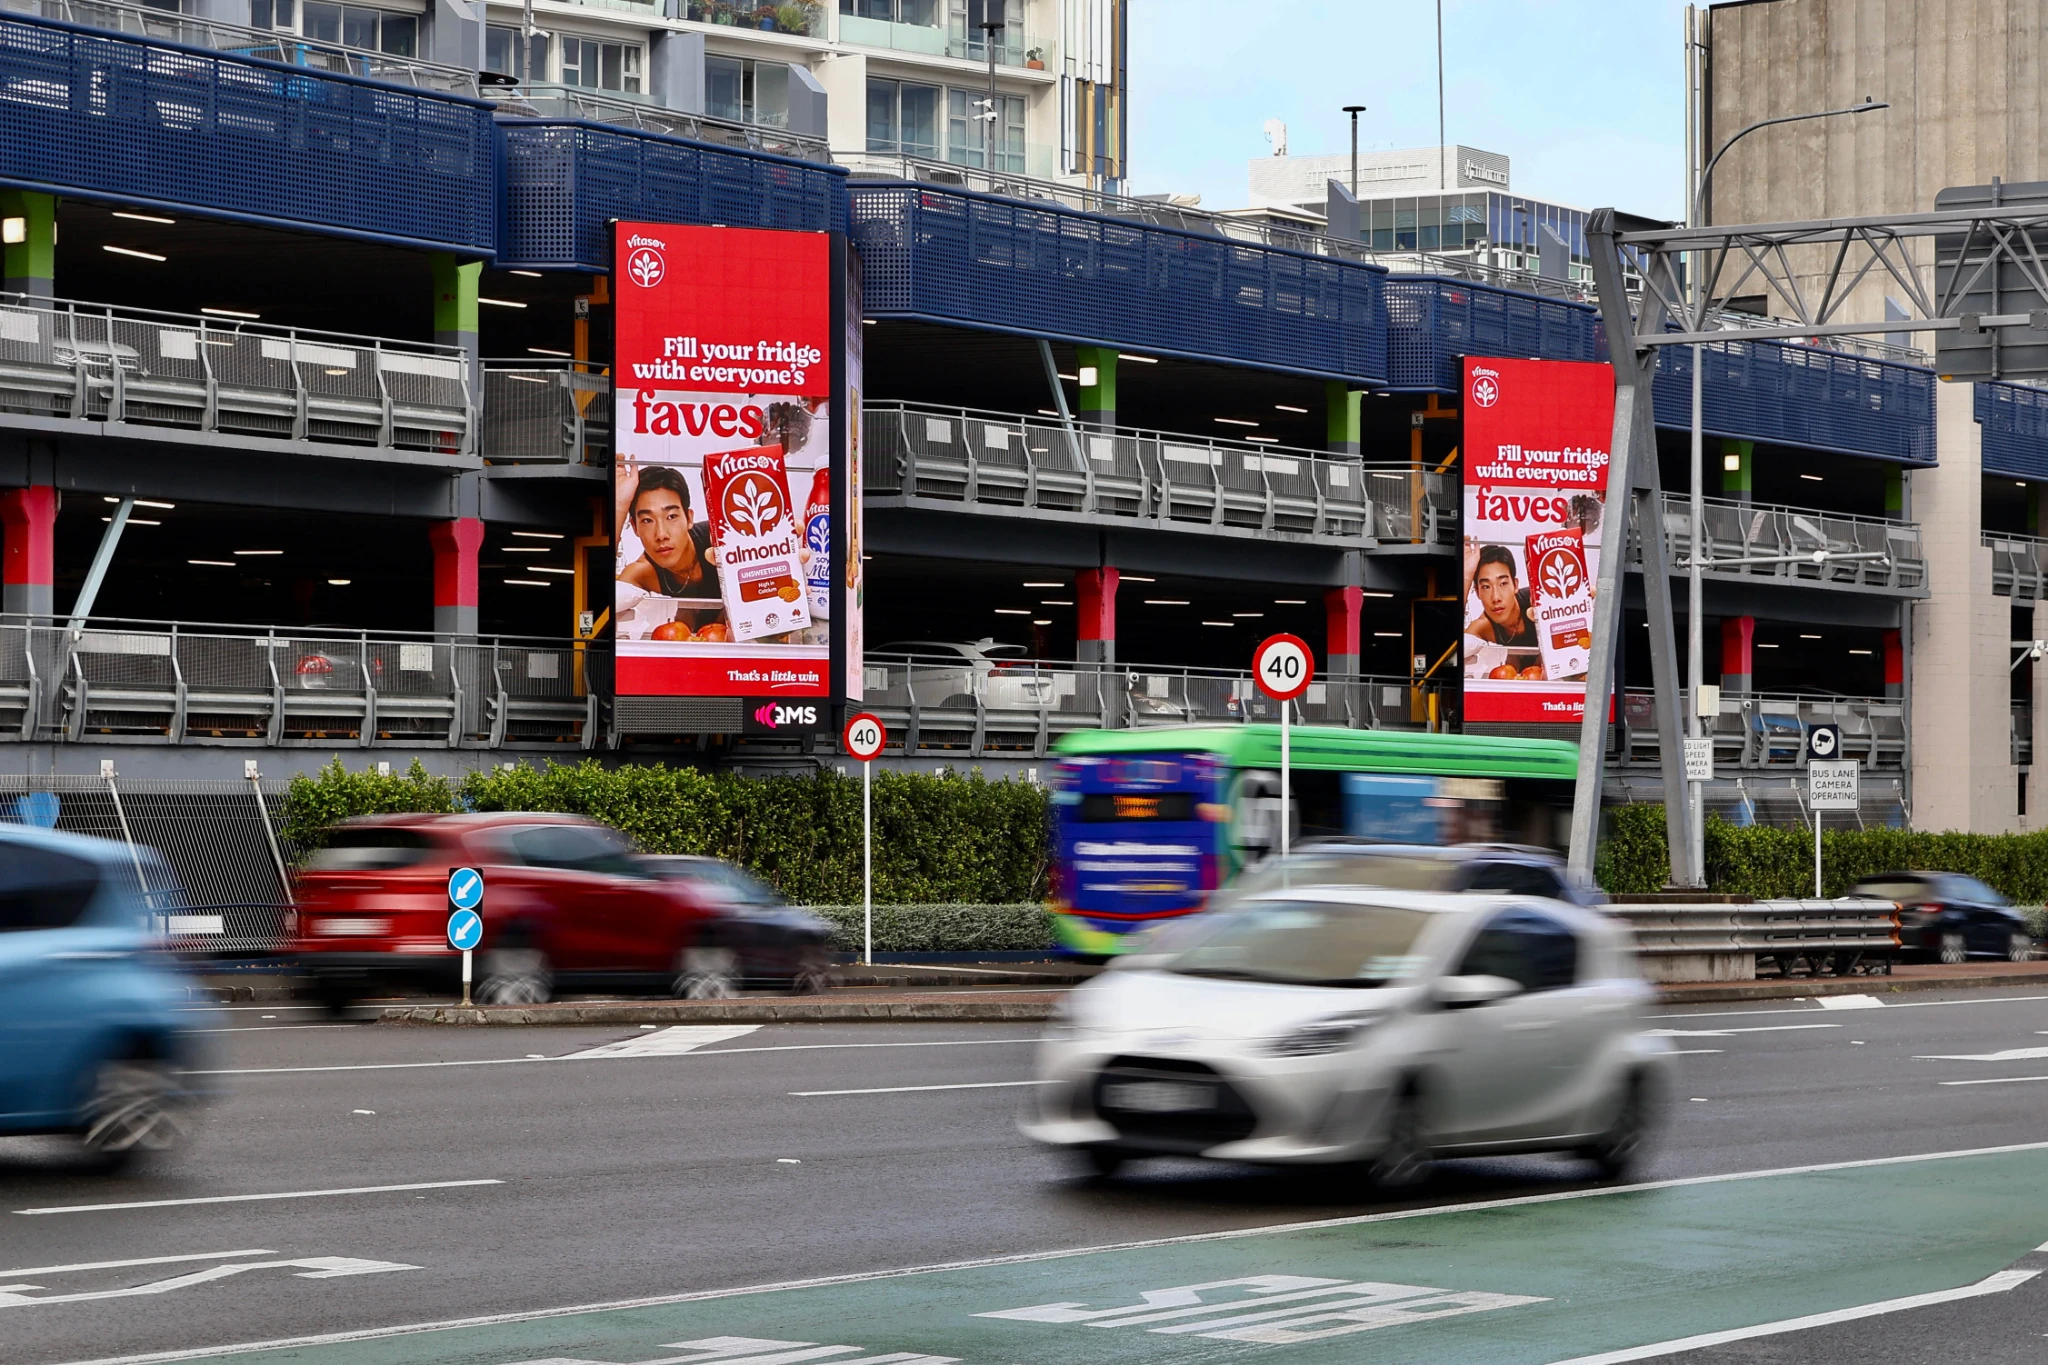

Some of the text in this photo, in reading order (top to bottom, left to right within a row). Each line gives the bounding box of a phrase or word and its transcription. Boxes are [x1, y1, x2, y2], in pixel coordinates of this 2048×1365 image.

[663, 336, 821, 368] Fill your fridge
[632, 358, 805, 388] with everyone's
[633, 387, 763, 438] faves
[1497, 445, 1609, 468] Fill your fridge
[1475, 462, 1598, 484] with everyone's
[1476, 485, 1569, 524] faves
[725, 537, 791, 565] almond
[741, 565, 787, 578] UNSWEETENED
[1541, 599, 1587, 621] almond
[727, 670, 819, 682] That's a little win
[1267, 656, 1299, 678] 40
[764, 702, 817, 728] QMS
[1542, 701, 1566, 711] That's
[1566, 703, 1572, 711] a
[854, 729, 876, 745] 40
[1812, 770, 1856, 778] BUS LANE
[1815, 781, 1852, 789] CAMERA
[1811, 792, 1857, 800] OPERATING
[969, 1274, 1554, 1344] BUS
